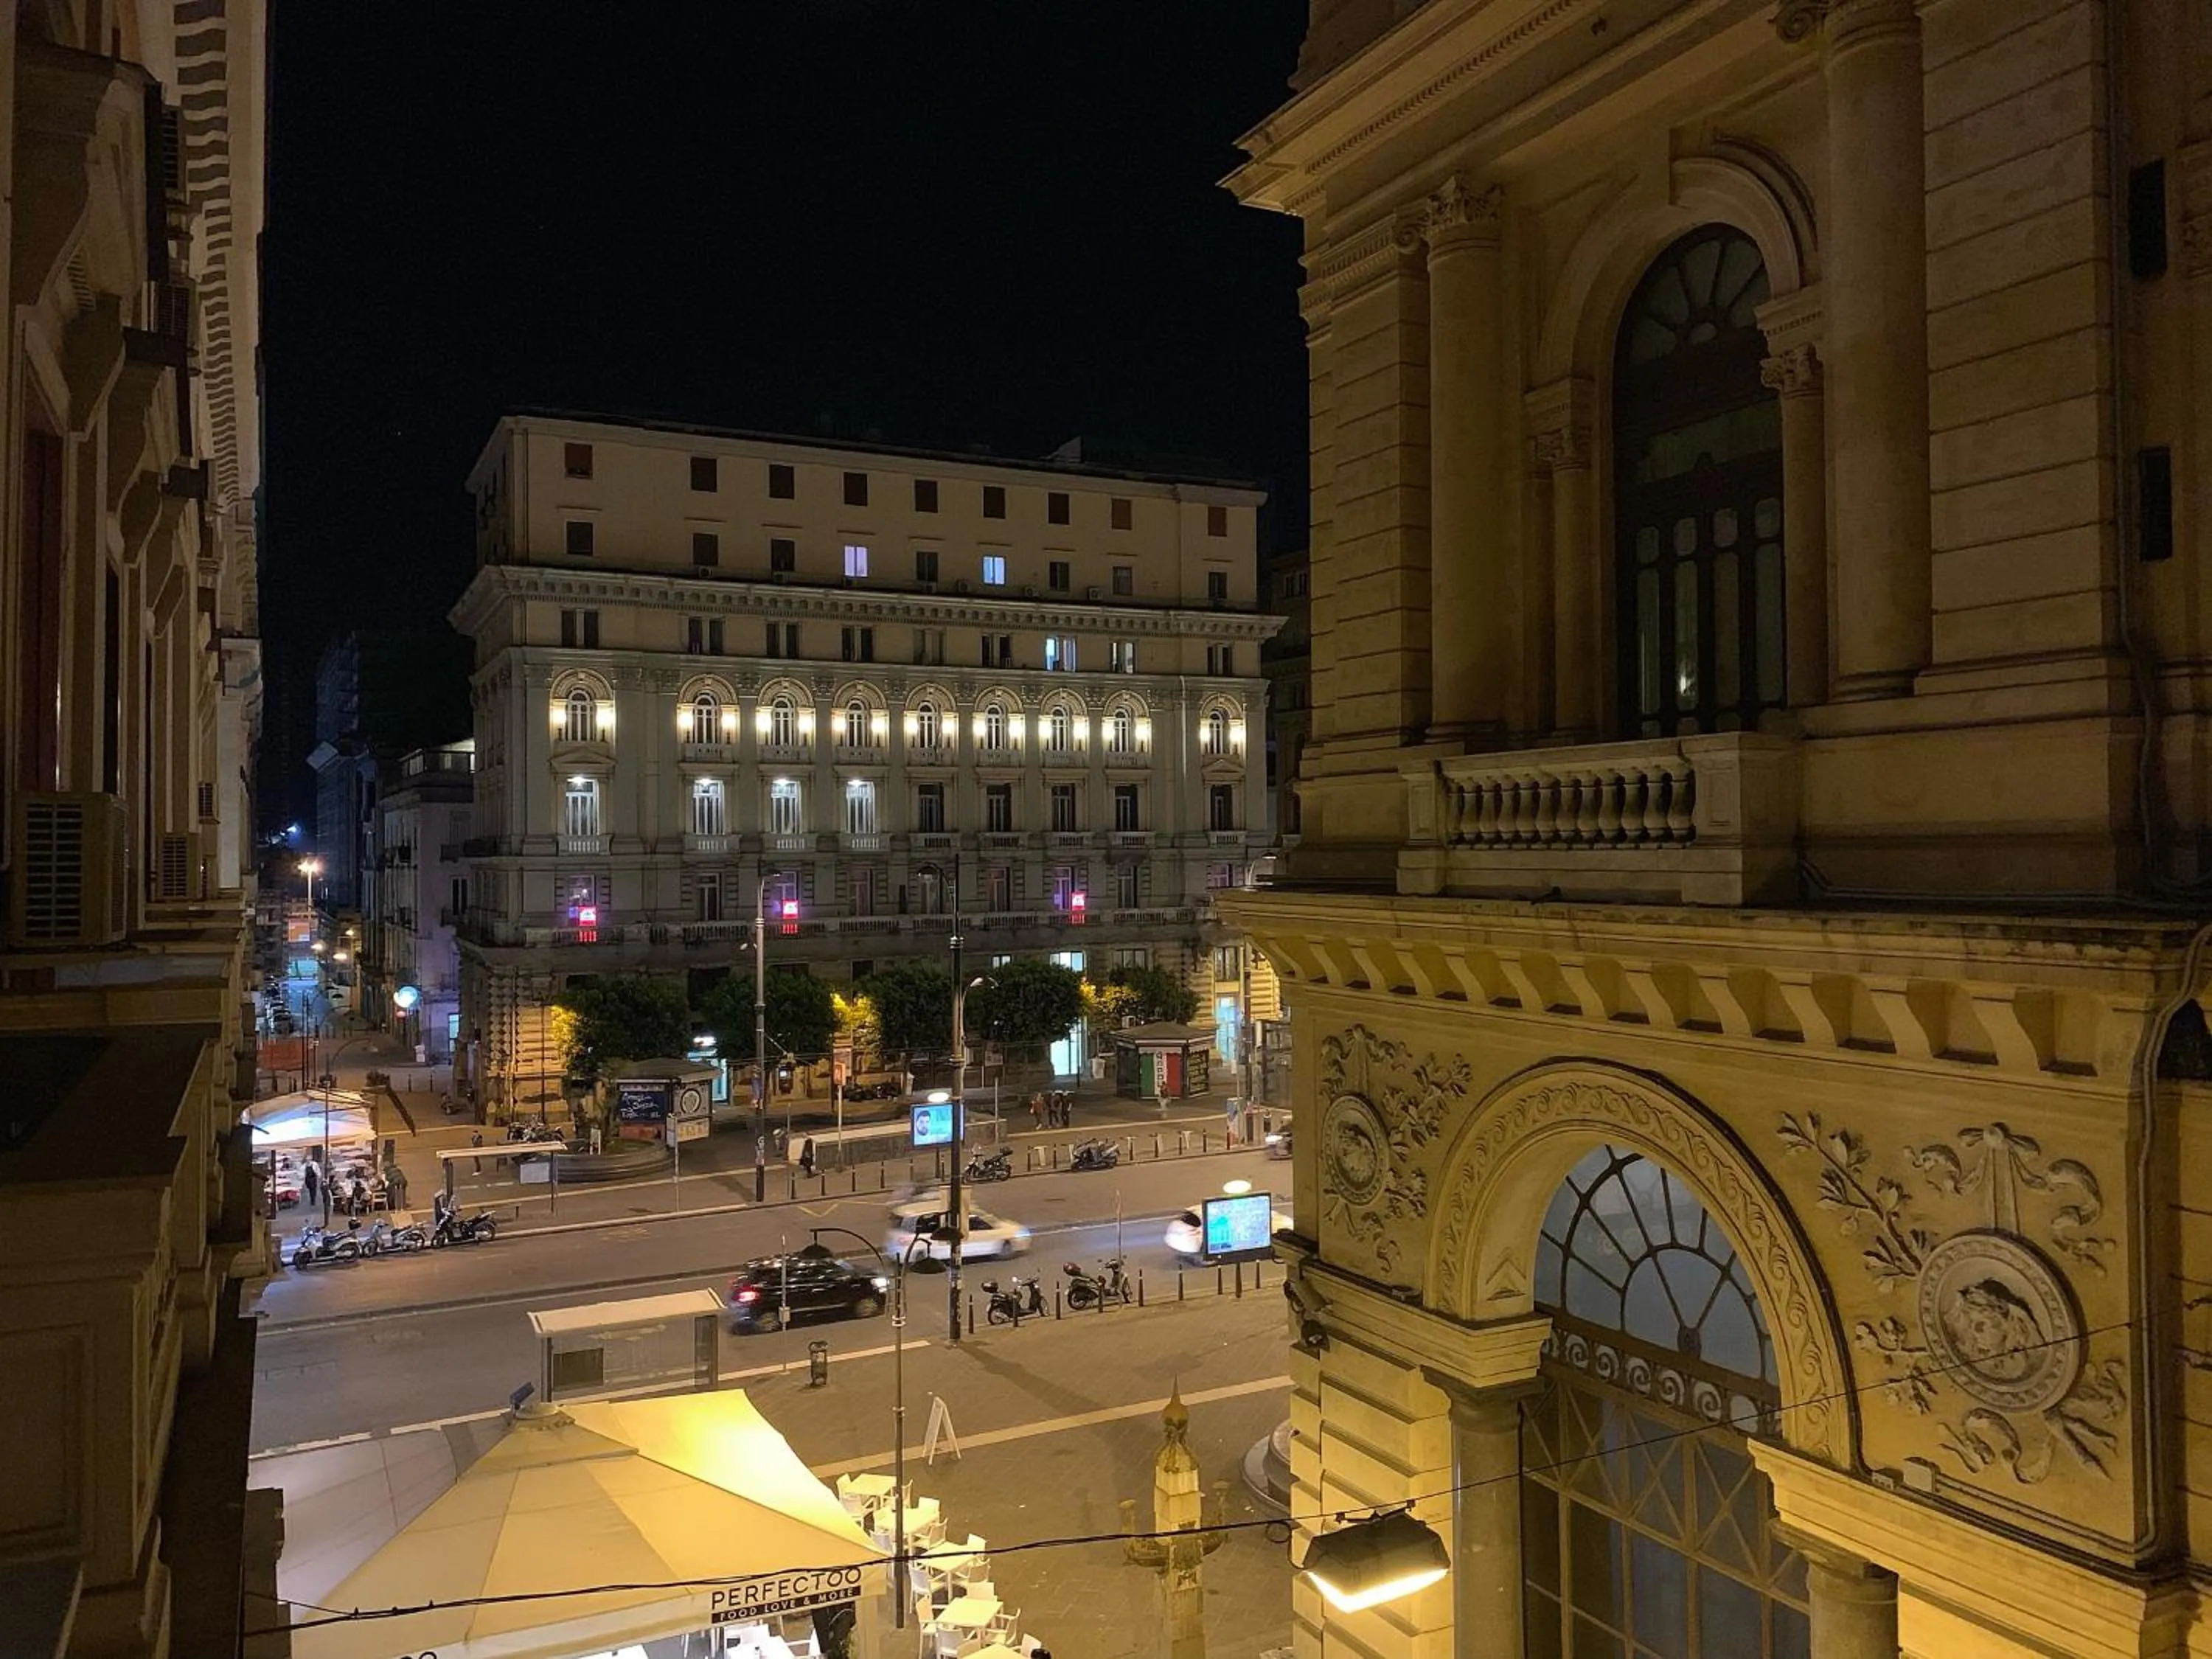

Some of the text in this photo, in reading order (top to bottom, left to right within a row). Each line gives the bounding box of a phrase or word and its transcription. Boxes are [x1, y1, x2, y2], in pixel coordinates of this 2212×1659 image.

[712, 1567, 861, 1610] PERFECTOO
[720, 1589, 852, 1621] FOOD LOVE & MORE
